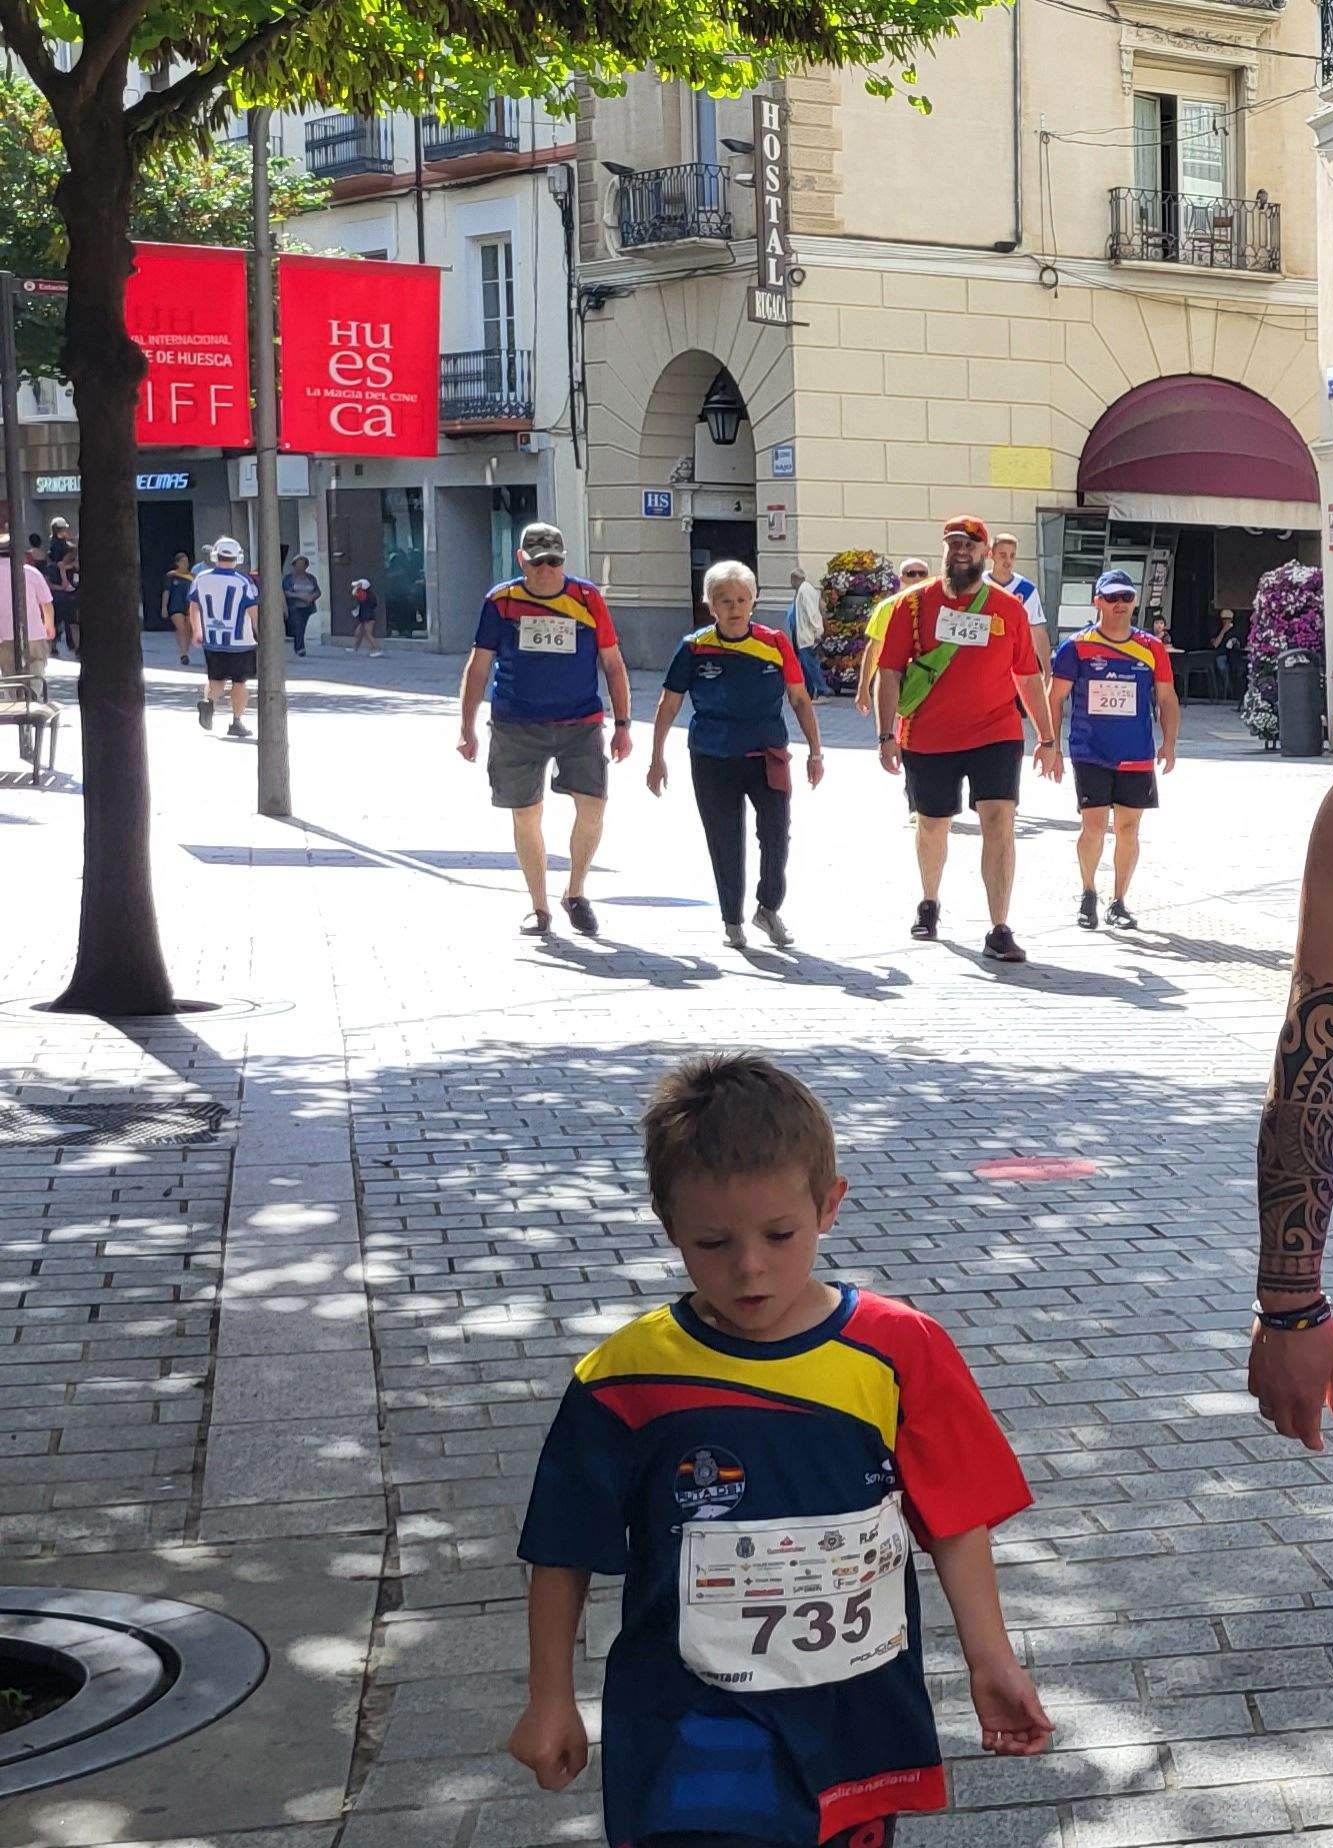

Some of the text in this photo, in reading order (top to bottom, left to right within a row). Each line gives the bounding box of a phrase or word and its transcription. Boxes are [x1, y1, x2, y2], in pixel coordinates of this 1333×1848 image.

[762, 101, 784, 286] HOSTAL
[755, 290, 787, 323] RUGACA
[149, 335, 232, 345] INTERNACIONAL
[156, 351, 175, 363] DE
[177, 352, 232, 367] HUESCA
[147, 381, 234, 426] IFF
[646, 493, 669, 508] HS
[533, 633, 564, 646] 616
[950, 626, 978, 640] 145
[1100, 697, 1127, 708] 207
[741, 1588, 872, 1656] 735
